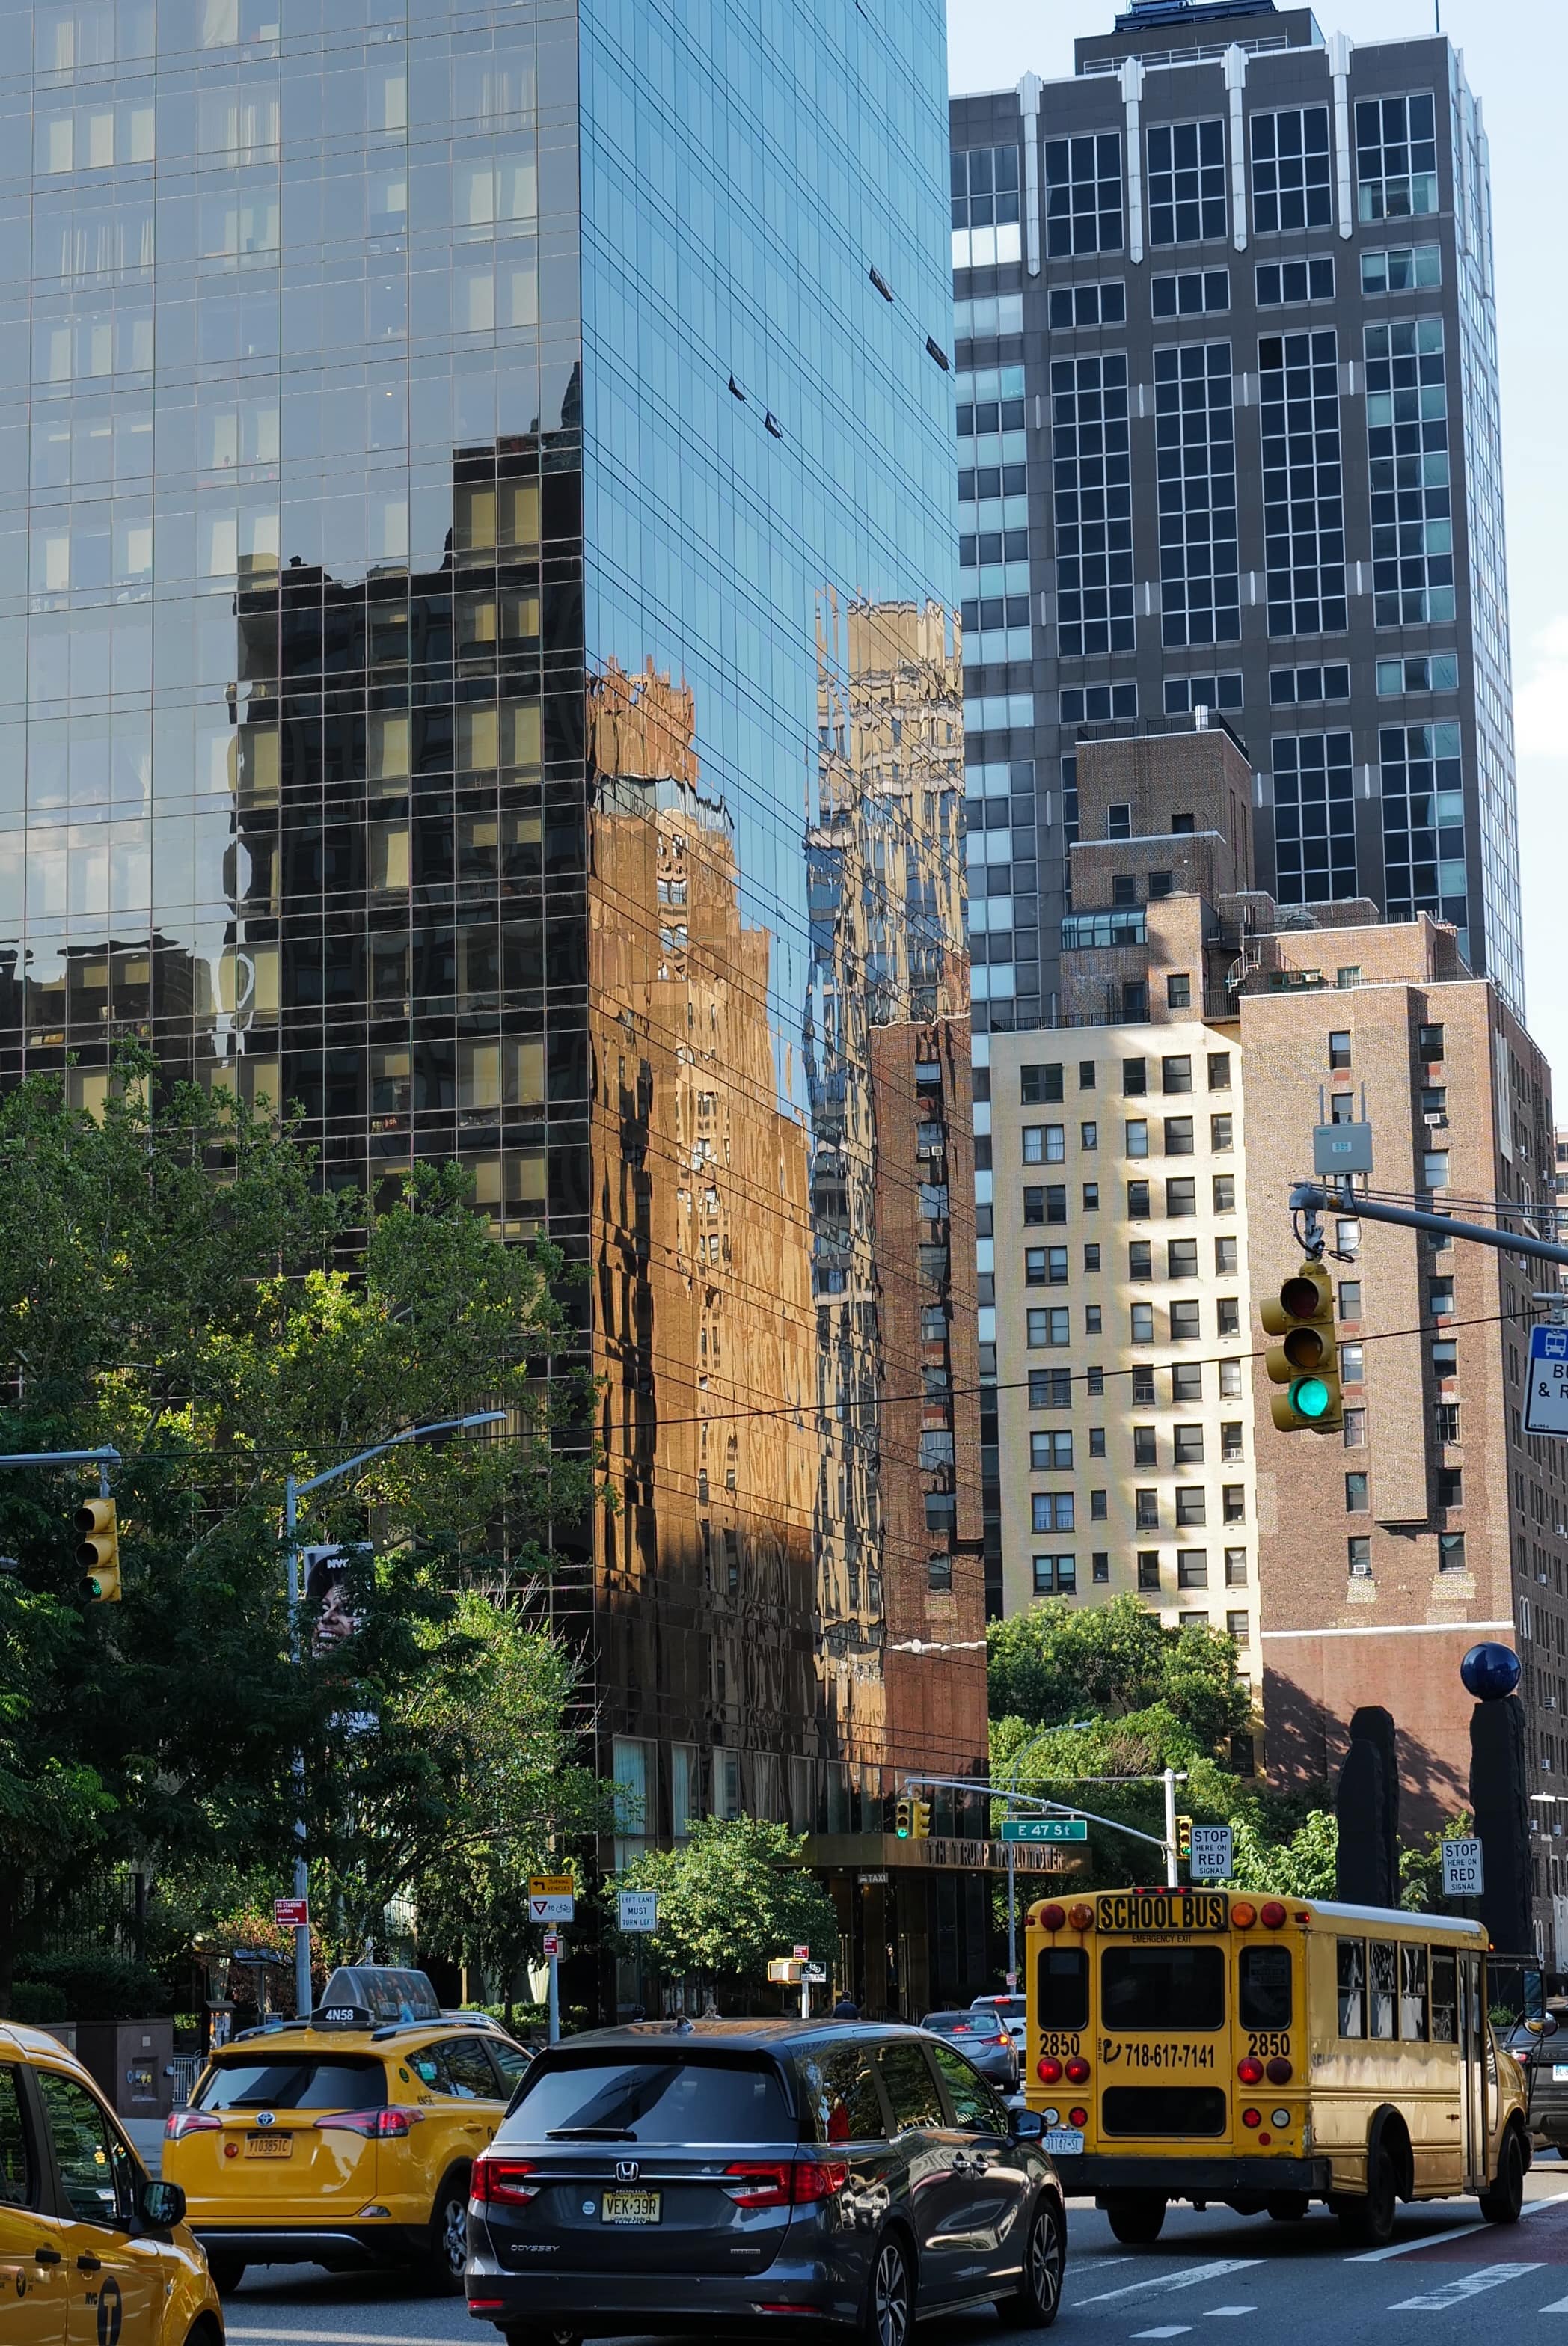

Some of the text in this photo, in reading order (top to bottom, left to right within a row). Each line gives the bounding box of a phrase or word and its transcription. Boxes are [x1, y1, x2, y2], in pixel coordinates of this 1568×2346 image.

[1019, 1825, 1071, 1836] E 47 St
[1195, 1830, 1228, 1843] STOP
[952, 1841, 990, 1867] TRUMP
[1445, 1843, 1477, 1857] STOP
[1198, 1854, 1225, 1865] RED
[867, 1873, 886, 1884] TAXI
[1450, 1868, 1475, 1881] RED
[1451, 1883, 1476, 1891] SIGNAL
[1100, 1896, 1222, 1929] SCHOOL BUS
[1132, 1933, 1192, 1944] EMERGENCY EXIT
[325, 2009, 354, 2021] 4N58
[1039, 2033, 1080, 2056] 2850
[1248, 2033, 1290, 2057] 2850
[1124, 2043, 1215, 2068] 718-617-7141
[85, 2291, 98, 2305] NYC
